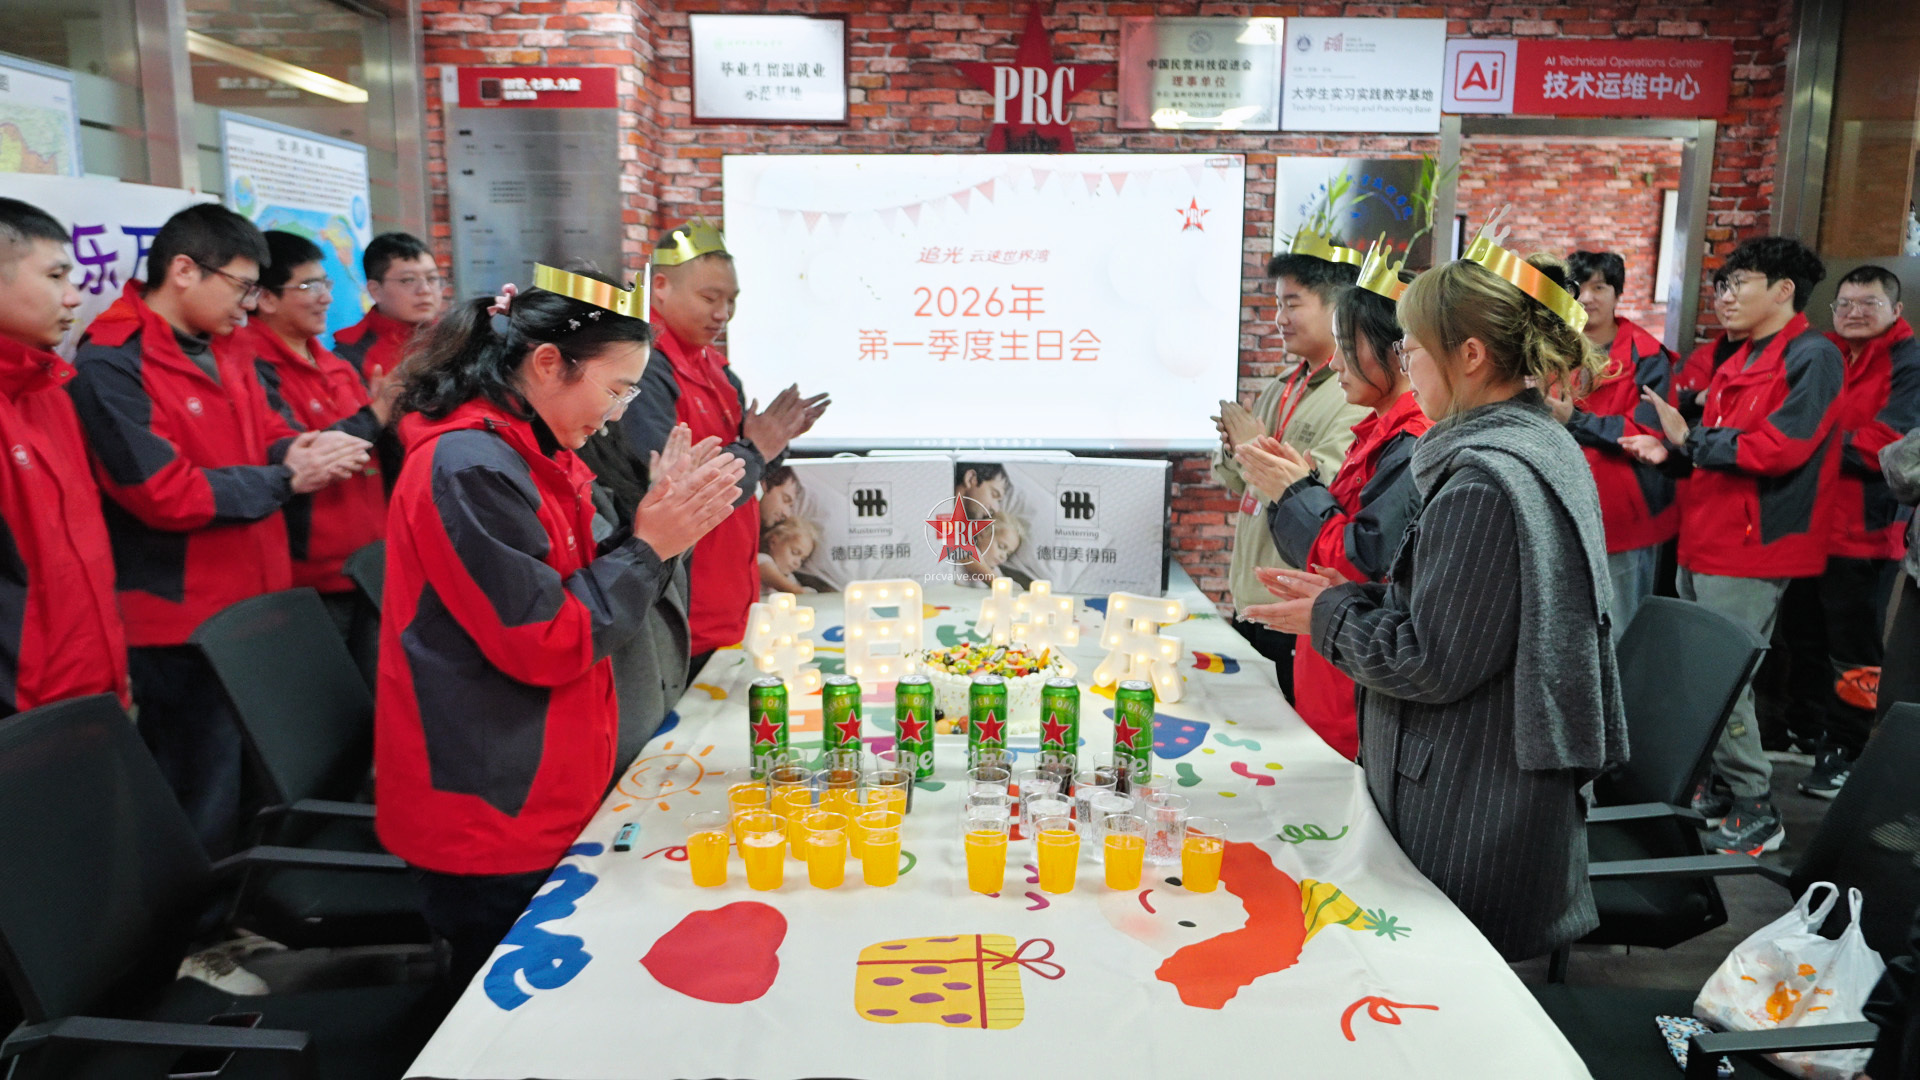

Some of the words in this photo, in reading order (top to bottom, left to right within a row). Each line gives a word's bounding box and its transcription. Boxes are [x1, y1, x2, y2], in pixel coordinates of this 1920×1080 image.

[1147, 58, 1252, 71] 中国民营科技促进会
[1544, 56, 1556, 66] AI
[1559, 55, 1606, 67] Technical
[1609, 57, 1666, 69] Operations
[1669, 58, 1704, 68] Center
[1171, 75, 1226, 88] 理事单位
[1461, 61, 1499, 91] Ai
[1543, 70, 1700, 101] 技术运维中心
[991, 65, 1076, 127] PRC
[1291, 87, 1435, 102] 大学生实习实践教学基地
[1329, 103, 1360, 113] Training
[1362, 104, 1375, 112] and
[1377, 104, 1413, 115] Practicing
[1414, 104, 1432, 113] Base
[913, 283, 1046, 322] 2026年
[857, 328, 1102, 362] 第一季度生日会
[1054, 528, 1100, 539] Musterring
[831, 542, 911, 561] 德国美得丽
[1036, 545, 1117, 564] 德国美得丽
